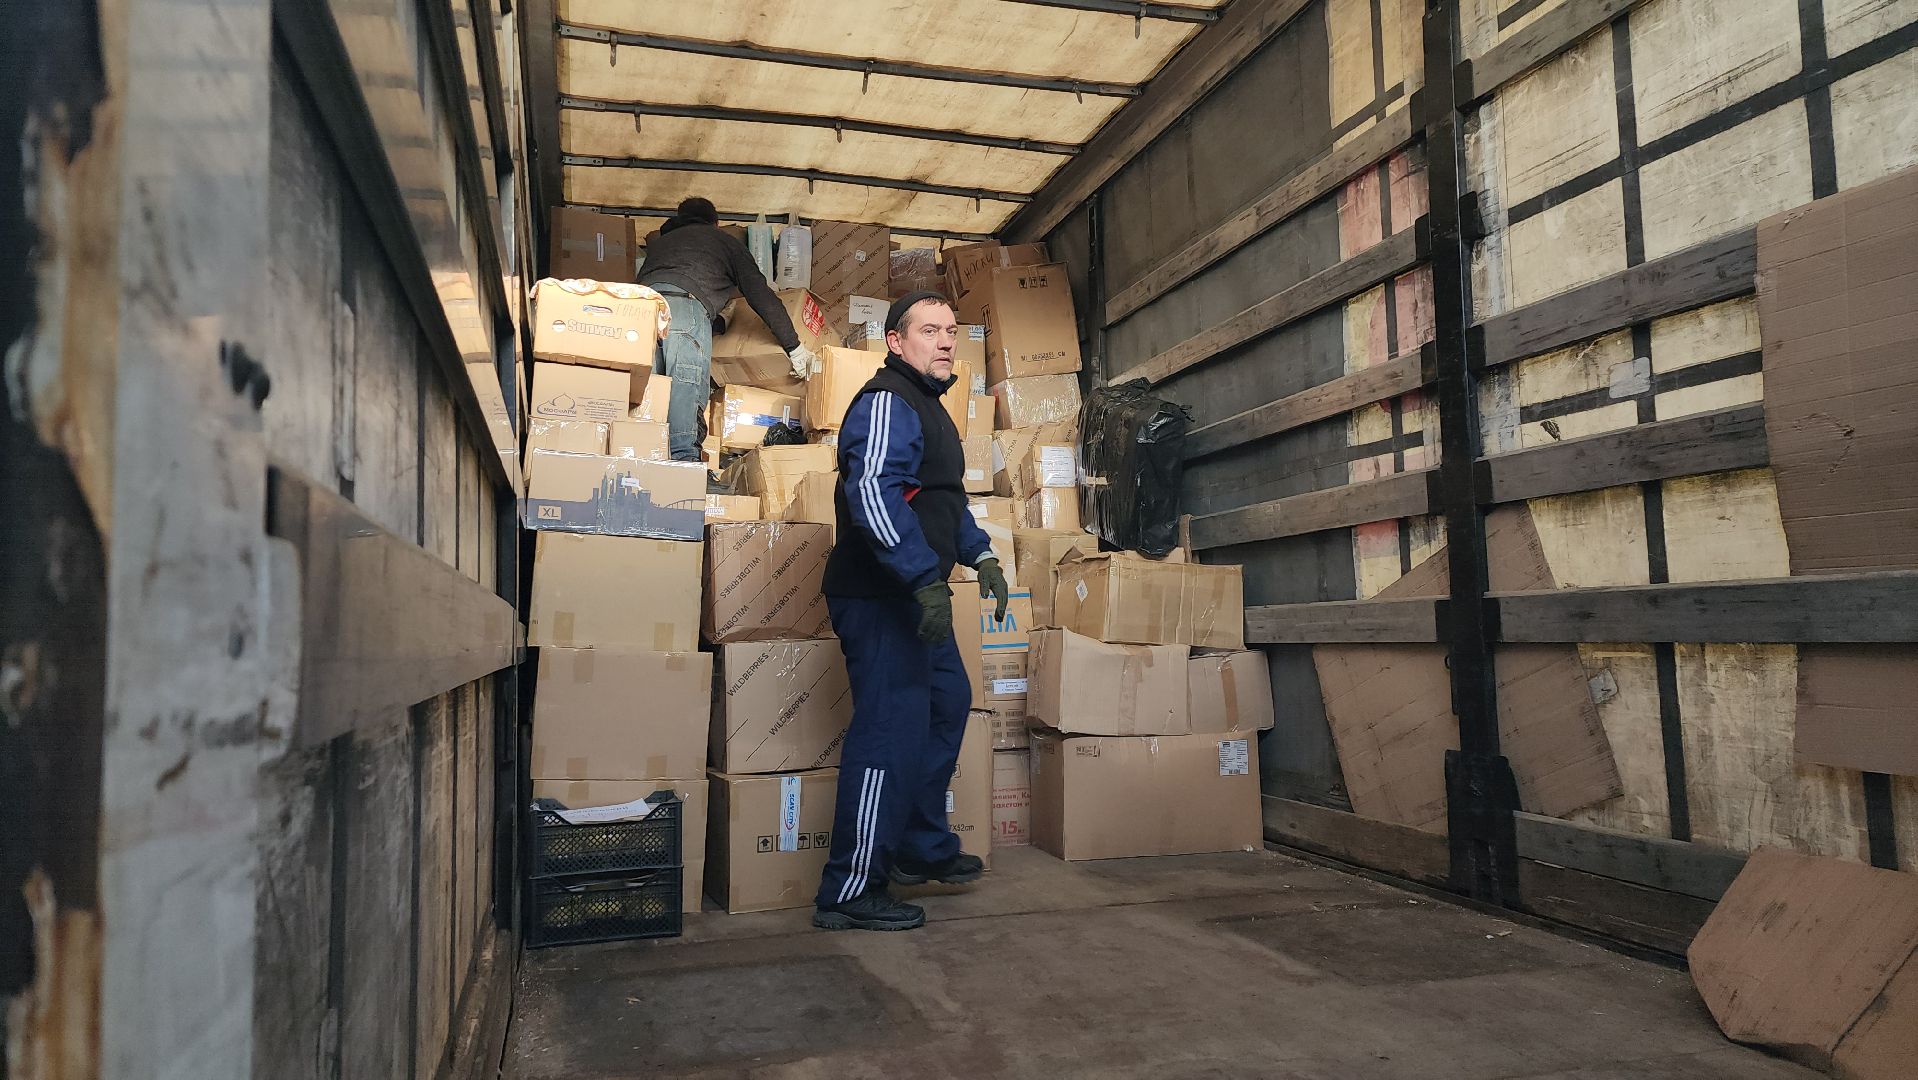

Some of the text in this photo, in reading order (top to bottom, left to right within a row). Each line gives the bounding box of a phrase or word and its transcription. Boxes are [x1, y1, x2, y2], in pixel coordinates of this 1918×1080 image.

[567, 318, 623, 339] Sunway
[543, 507, 559, 518] XL
[720, 557, 761, 598] WILDBERRIES
[771, 540, 810, 580] WILDBERRIES
[760, 585, 800, 626] WILDBERRIES
[727, 652, 769, 697] WILDBERRIES
[769, 691, 810, 736] WILDBERRIES
[1001, 820, 1018, 835] 15
